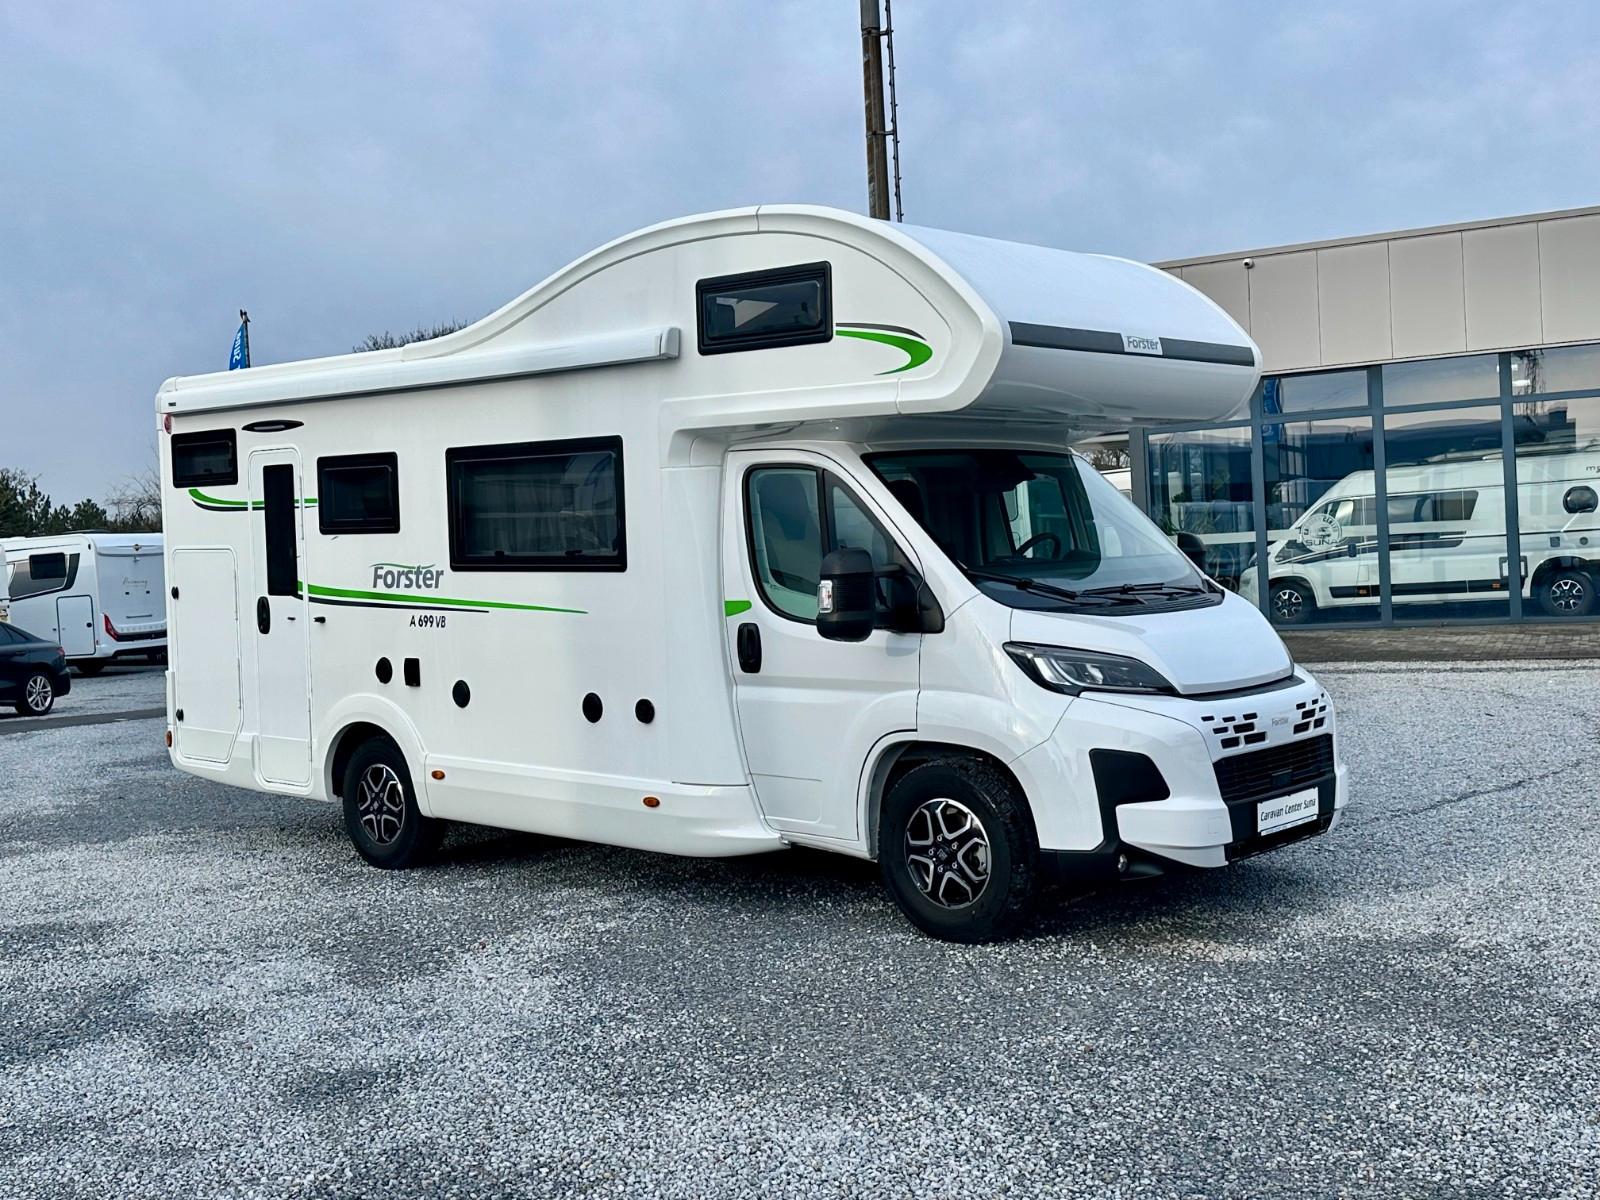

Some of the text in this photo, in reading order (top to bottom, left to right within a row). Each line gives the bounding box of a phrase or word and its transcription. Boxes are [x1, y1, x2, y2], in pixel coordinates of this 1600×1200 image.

[1127, 336, 1159, 350] Forster
[372, 564, 444, 589] Forster
[409, 615, 447, 628] A 699 VB
[1260, 798, 1316, 822] Caravan Center Suna
